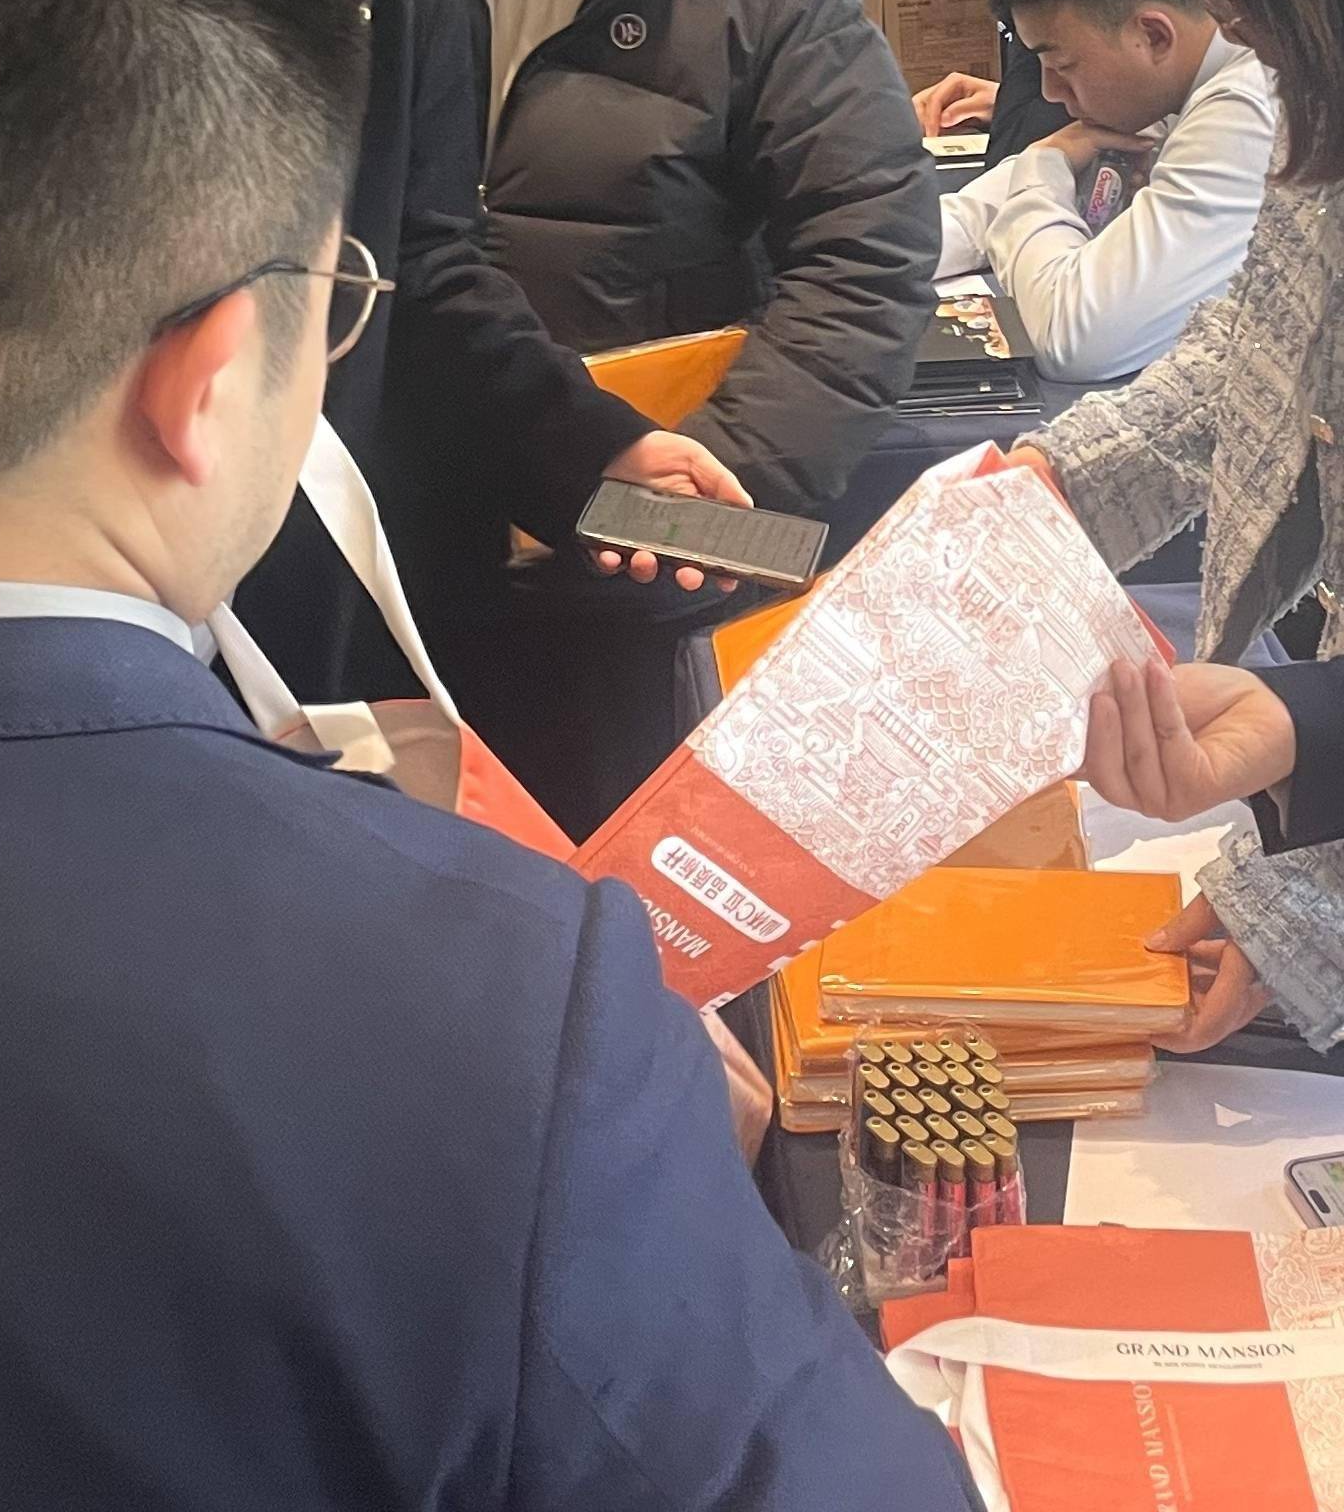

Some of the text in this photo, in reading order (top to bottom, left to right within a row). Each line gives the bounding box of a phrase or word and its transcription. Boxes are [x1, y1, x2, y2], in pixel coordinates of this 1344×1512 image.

[661, 845, 728, 900] 品质标杆
[1116, 1343, 1296, 1360] GRAND MANSION
